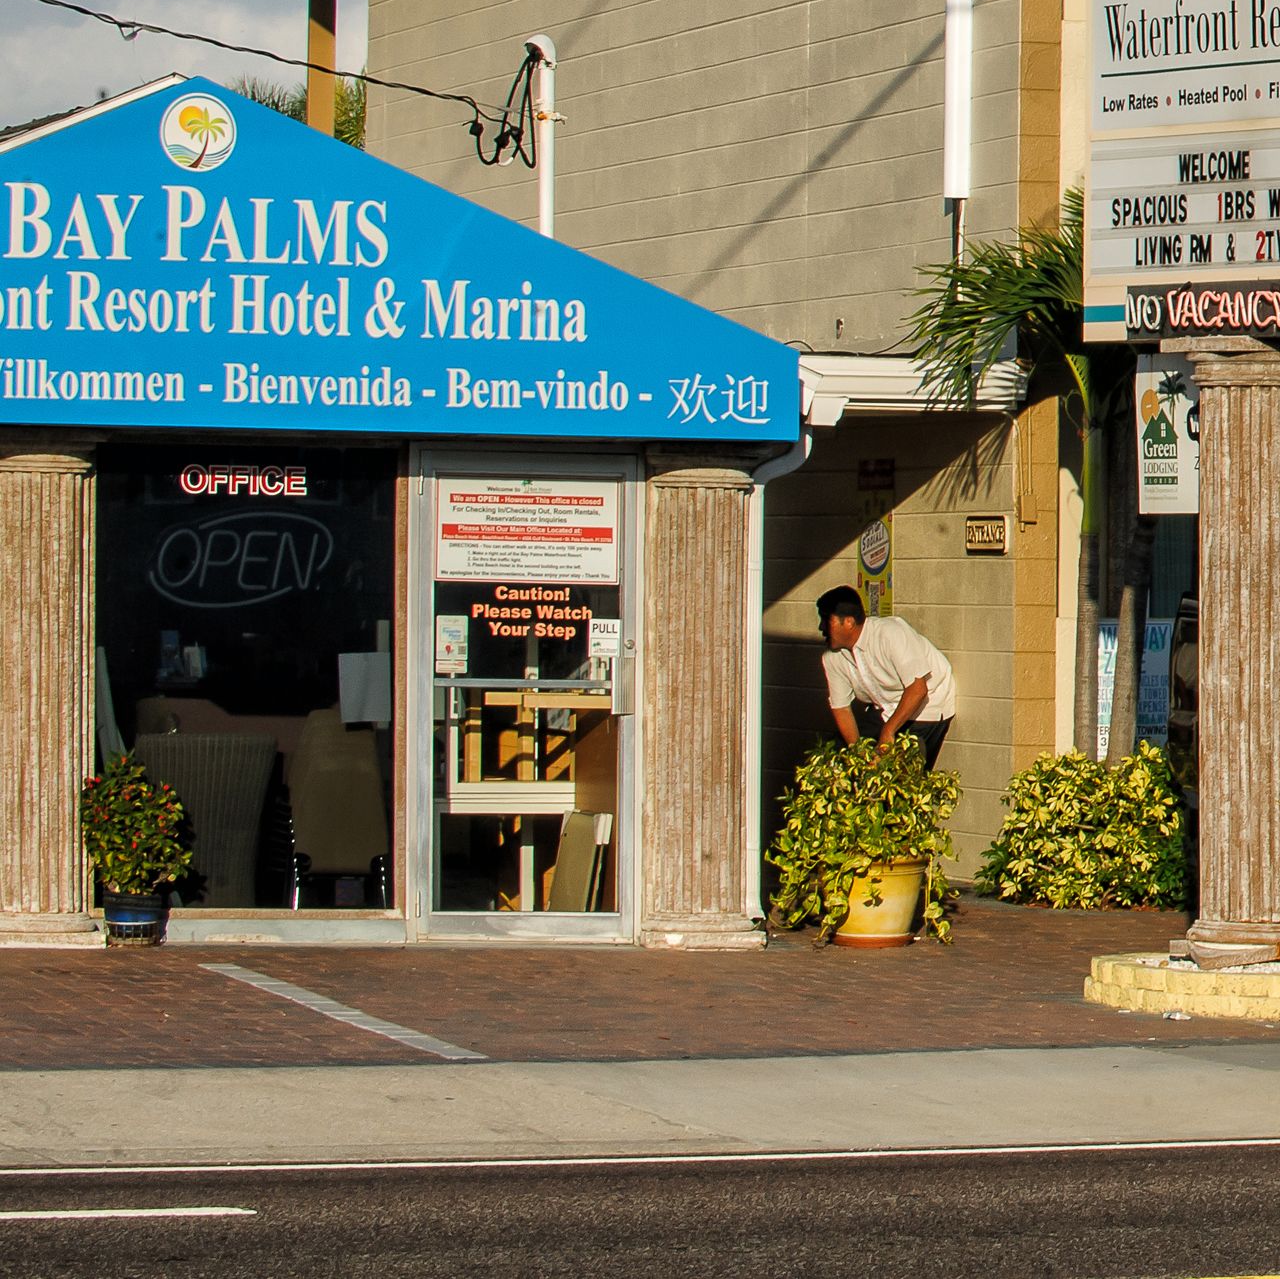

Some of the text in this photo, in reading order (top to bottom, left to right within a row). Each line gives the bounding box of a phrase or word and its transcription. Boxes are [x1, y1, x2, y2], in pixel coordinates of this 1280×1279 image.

[1103, 96, 1125, 113] Low
[1128, 93, 1159, 111] Rates
[1178, 87, 1219, 106] Heated
[1222, 84, 1247, 102] Pool
[1178, 150, 1250, 182] WELCOME
[1112, 194, 1187, 226] SPACIOUS
[1217, 190, 1255, 222] 1BRS
[3, 182, 388, 268] BAY PALMS
[1135, 233, 1182, 266] LIVING
[1190, 233, 1212, 263] RM
[1226, 232, 1236, 261] &
[65, 271, 216, 333] Resort
[229, 274, 350, 337] Hotel
[365, 277, 406, 339] &
[421, 280, 588, 342] Marina
[1125, 293, 1161, 330] NO
[0, 358, 186, 402] illkommen
[222, 363, 412, 407] Bienvenida
[445, 368, 629, 410] Bem-vindo
[667, 373, 772, 425] 欢迎
[1144, 438, 1177, 457] Green
[180, 464, 308, 496] OFFICE
[1144, 462, 1178, 473] LODGING
[466, 506, 496, 514] Checking
[498, 506, 536, 515] In/Checking
[967, 525, 1005, 543] ENTRANCE
[495, 586, 570, 602] Caution!
[472, 603, 592, 620] Please Watch
[489, 622, 576, 640] Your Step
[592, 623, 618, 634] PULL
